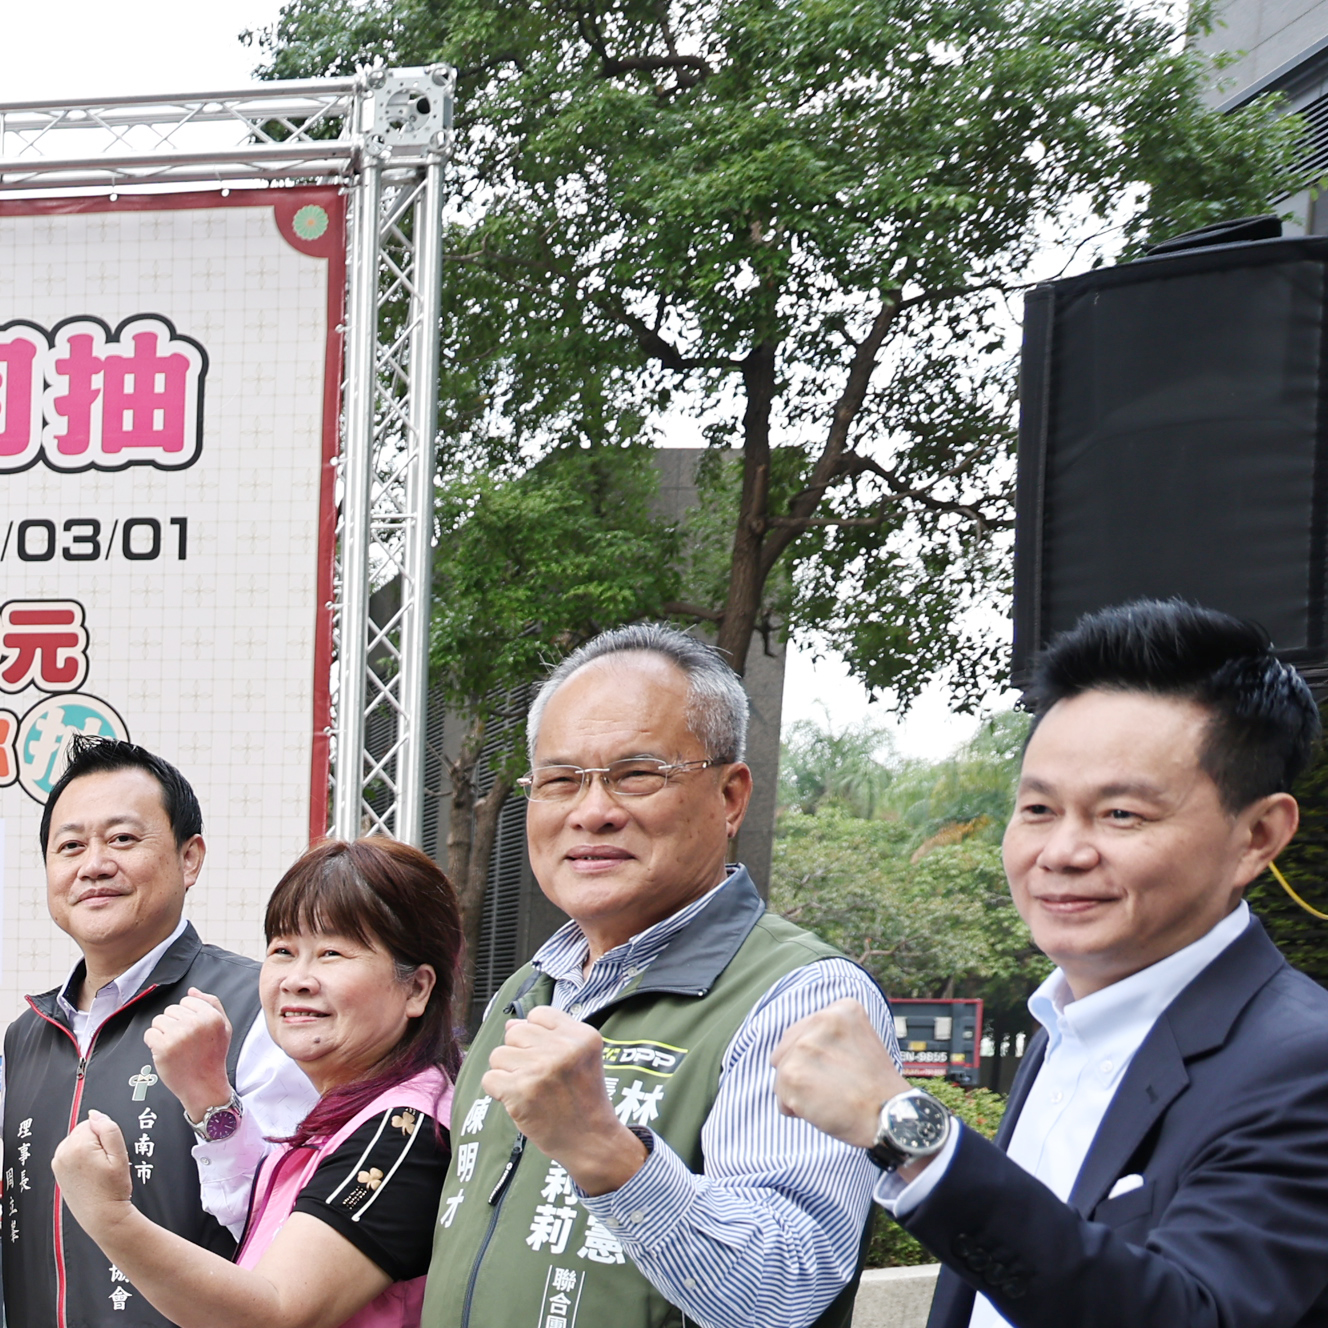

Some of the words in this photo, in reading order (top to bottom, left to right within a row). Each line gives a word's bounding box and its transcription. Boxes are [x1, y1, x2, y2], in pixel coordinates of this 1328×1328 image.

[620, 1048, 676, 1067] DPP
[17, 1118, 33, 1193] 理事長
[134, 1107, 158, 1185] 台南市
